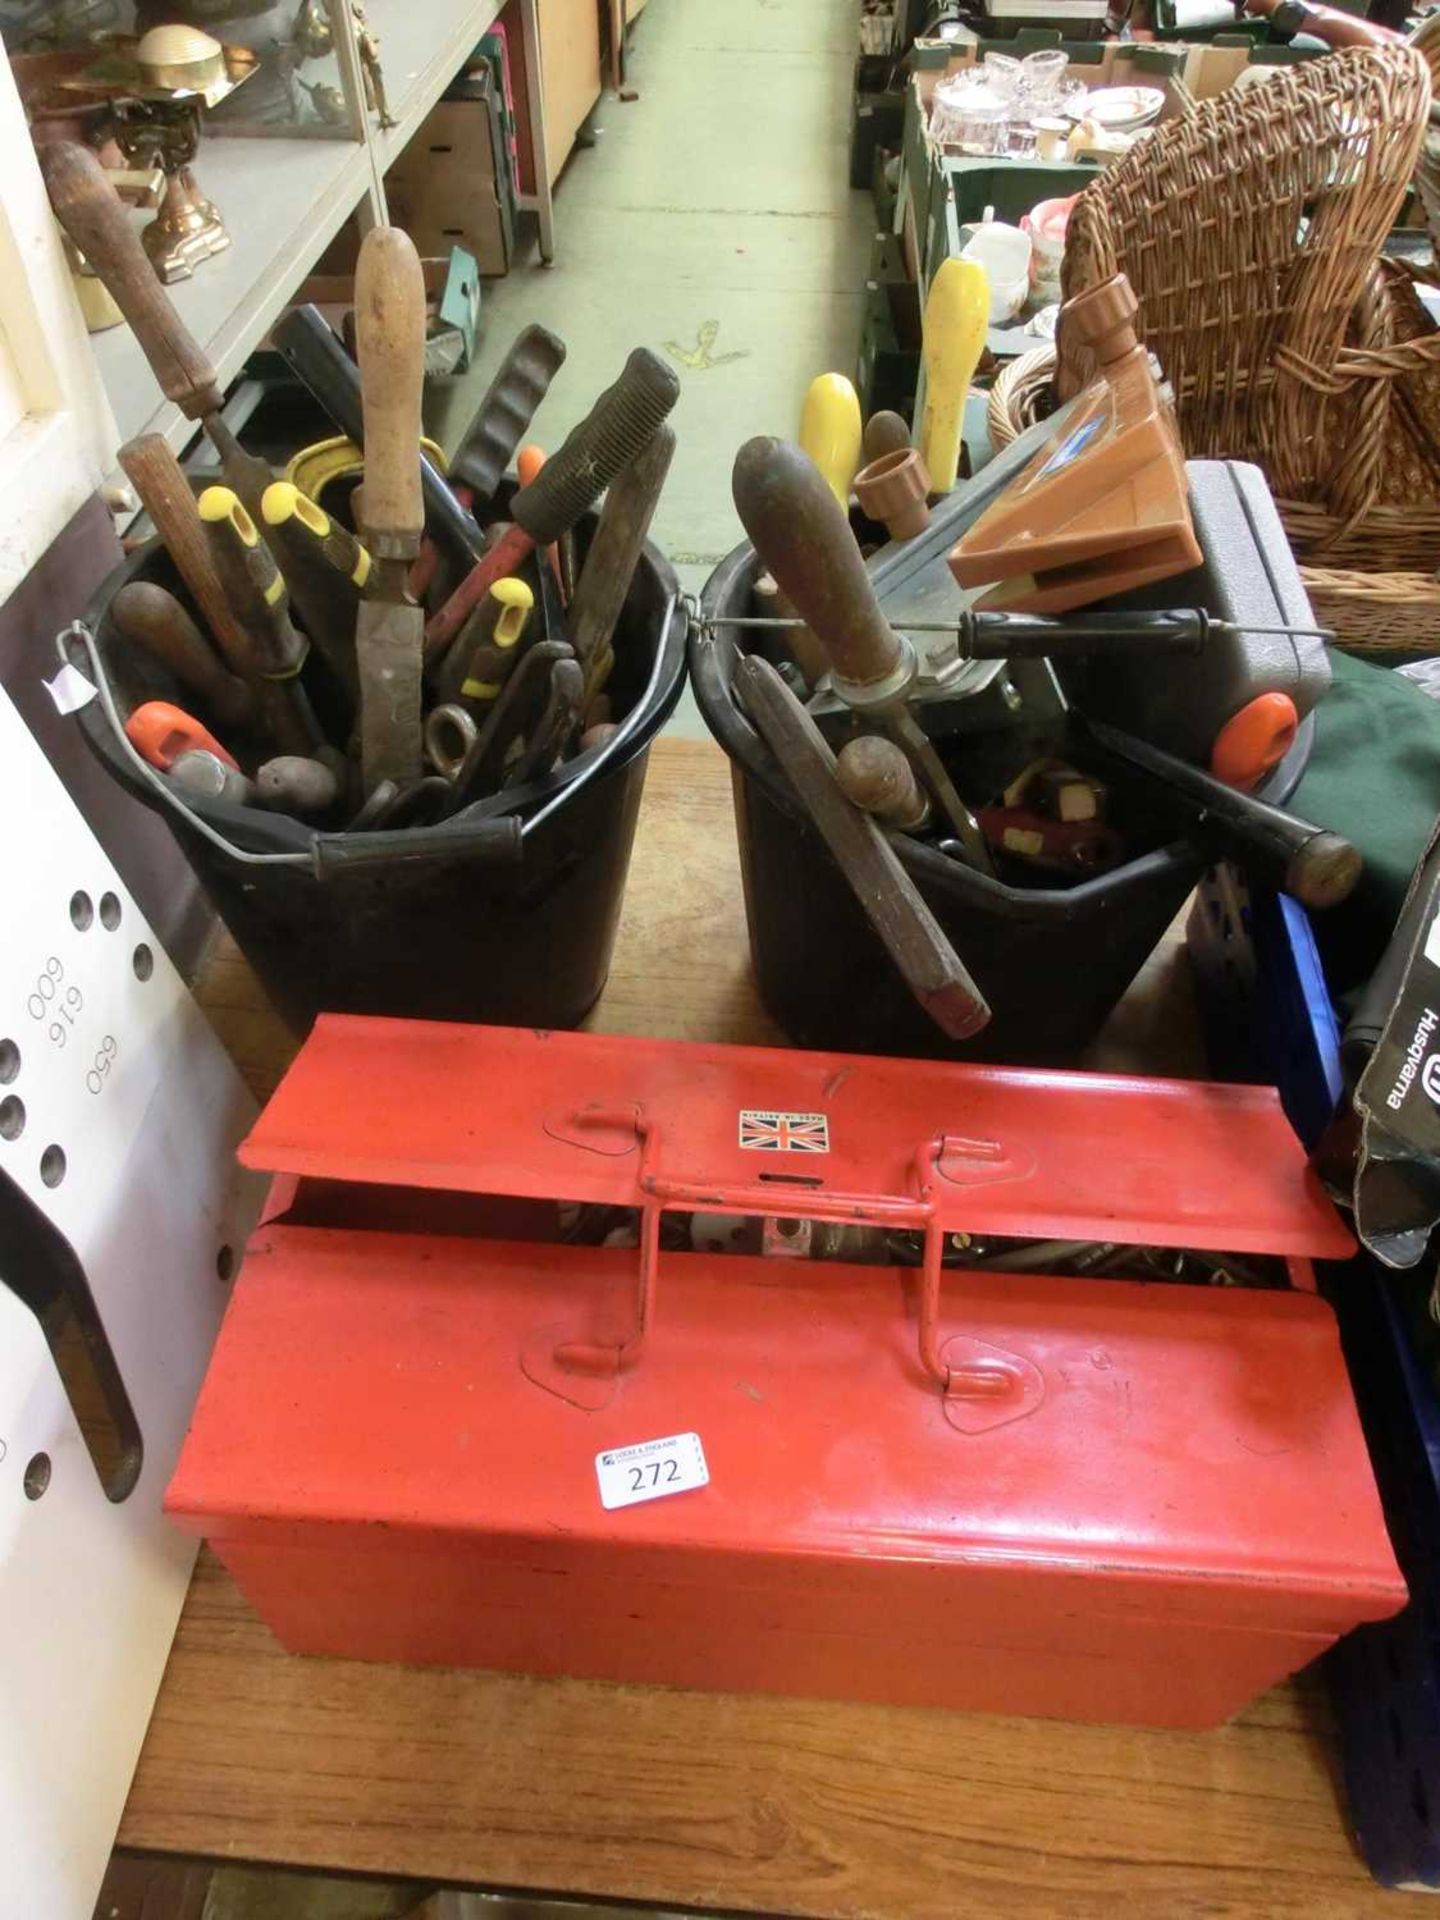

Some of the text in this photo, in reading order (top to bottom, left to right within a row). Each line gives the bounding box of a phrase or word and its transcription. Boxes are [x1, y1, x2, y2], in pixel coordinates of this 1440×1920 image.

[28, 956, 64, 1020] 600
[49, 986, 83, 1048] 616
[86, 1035, 117, 1095] 650
[1386, 1008, 1438, 1110] Husqvarna
[628, 1459, 681, 1491] 272
